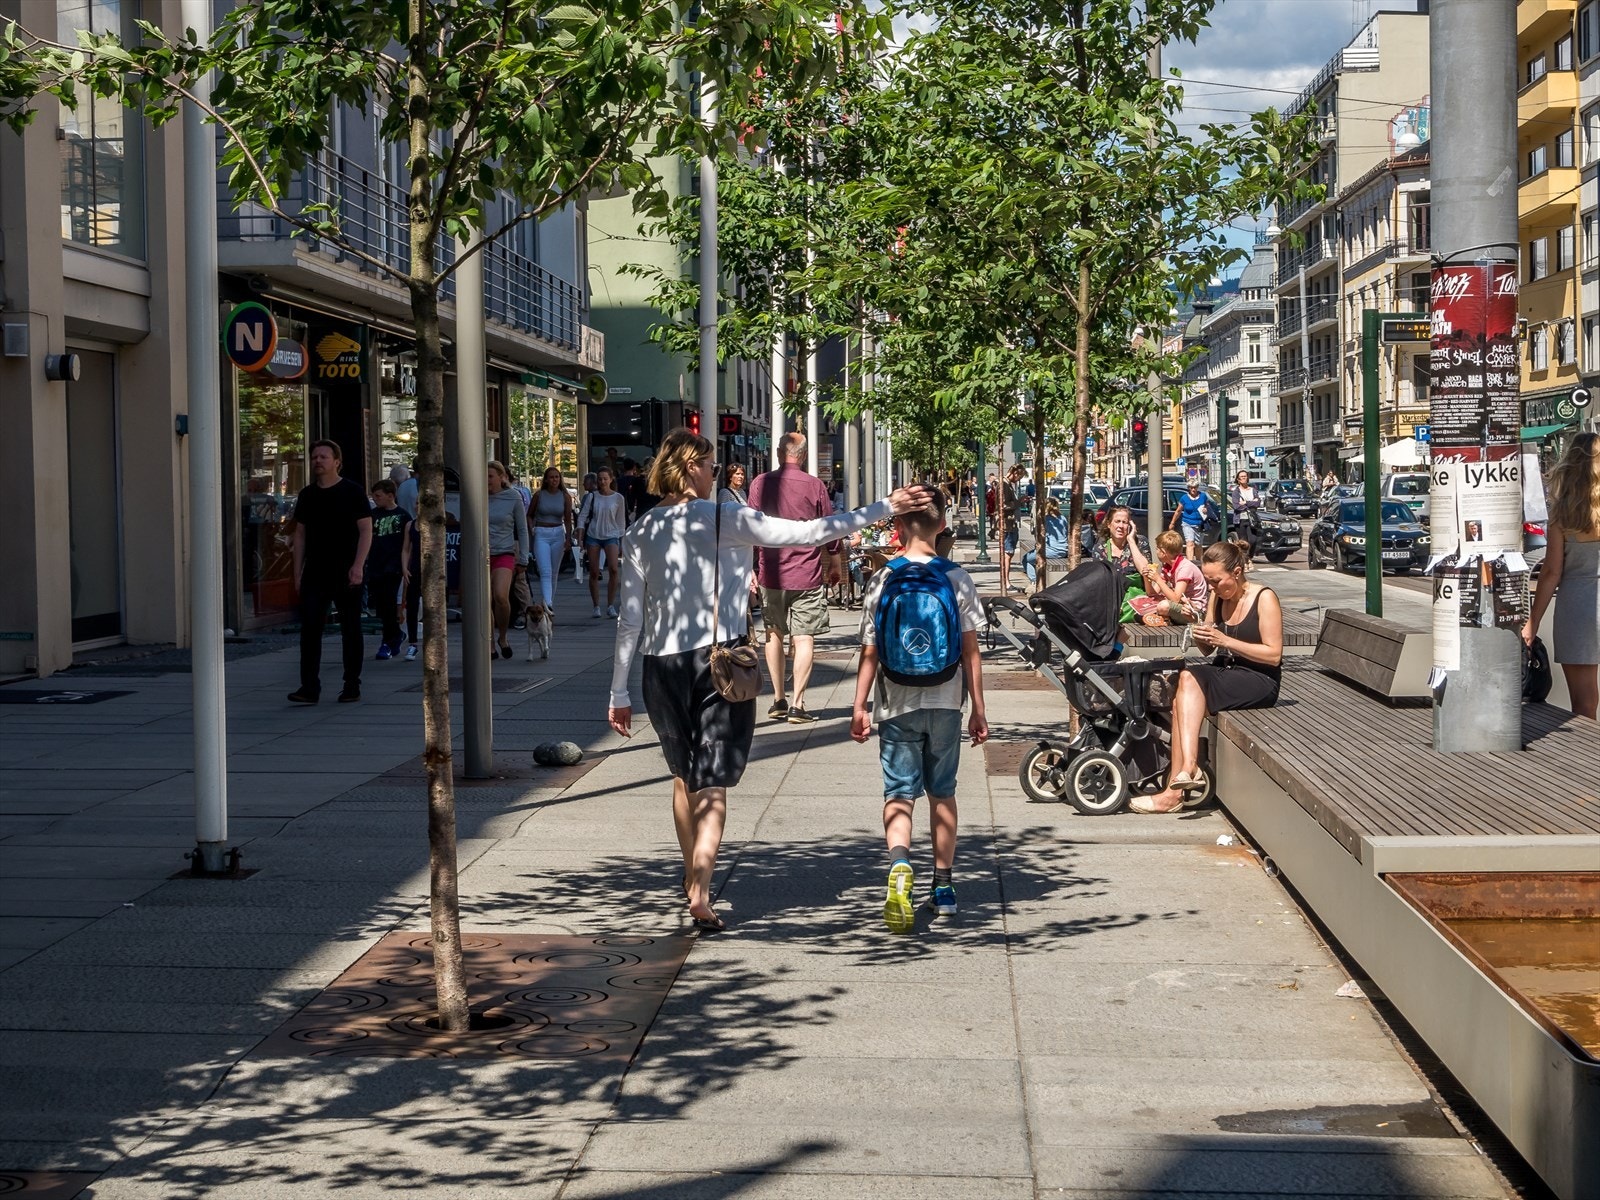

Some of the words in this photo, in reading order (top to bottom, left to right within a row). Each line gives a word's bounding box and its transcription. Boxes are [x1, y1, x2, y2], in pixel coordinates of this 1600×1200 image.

[235, 322, 263, 351] N
[1492, 344, 1513, 353] ALICE
[1431, 362, 1451, 370] ROPE
[1486, 353, 1516, 367] COOPER
[318, 363, 361, 378] TOTO
[1572, 389, 1588, 406] C
[723, 417, 738, 432] D
[1419, 427, 1427, 440] P
[1256, 447, 1263, 456] P
[1464, 462, 1518, 488] lykke
[446, 532, 461, 545] KTE
